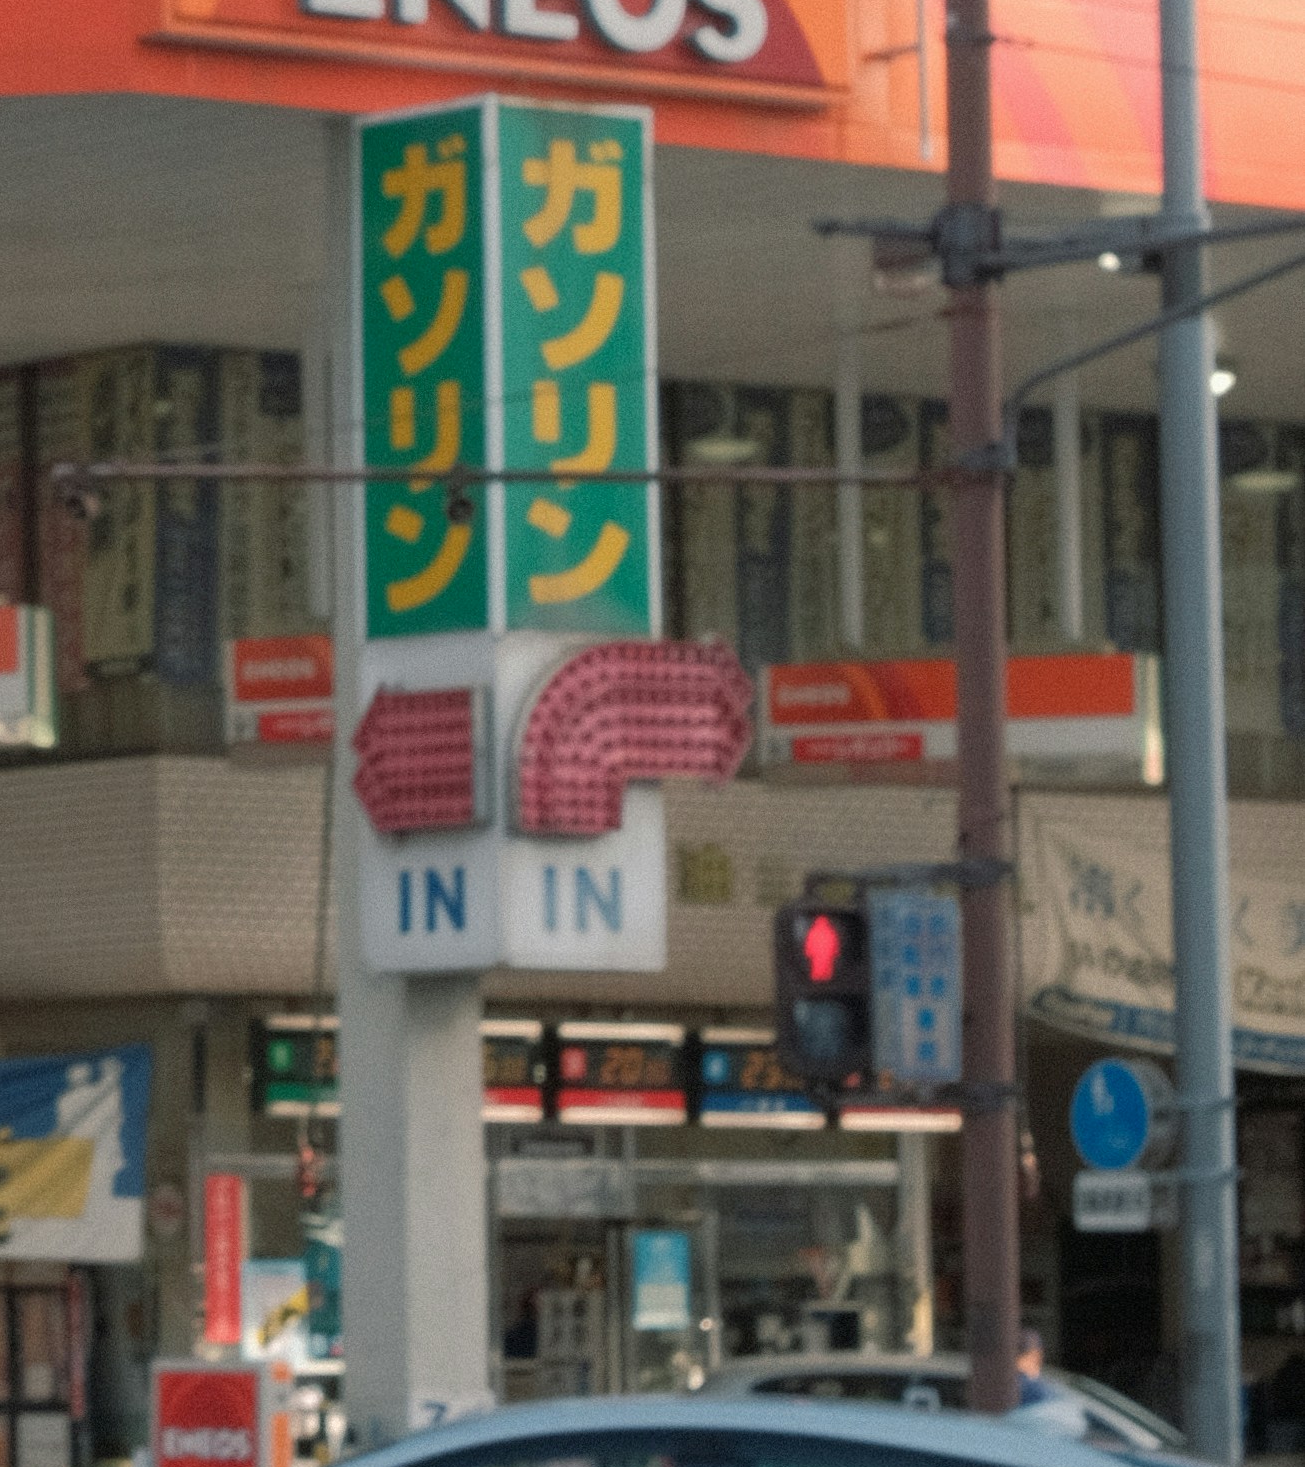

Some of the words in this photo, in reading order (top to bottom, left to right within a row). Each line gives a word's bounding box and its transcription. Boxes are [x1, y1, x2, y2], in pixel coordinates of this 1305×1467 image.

[380, 132, 472, 612] ガソリン
[520, 138, 630, 604] ガソリン
[398, 866, 467, 934] IN
[541, 865, 624, 934] IN
